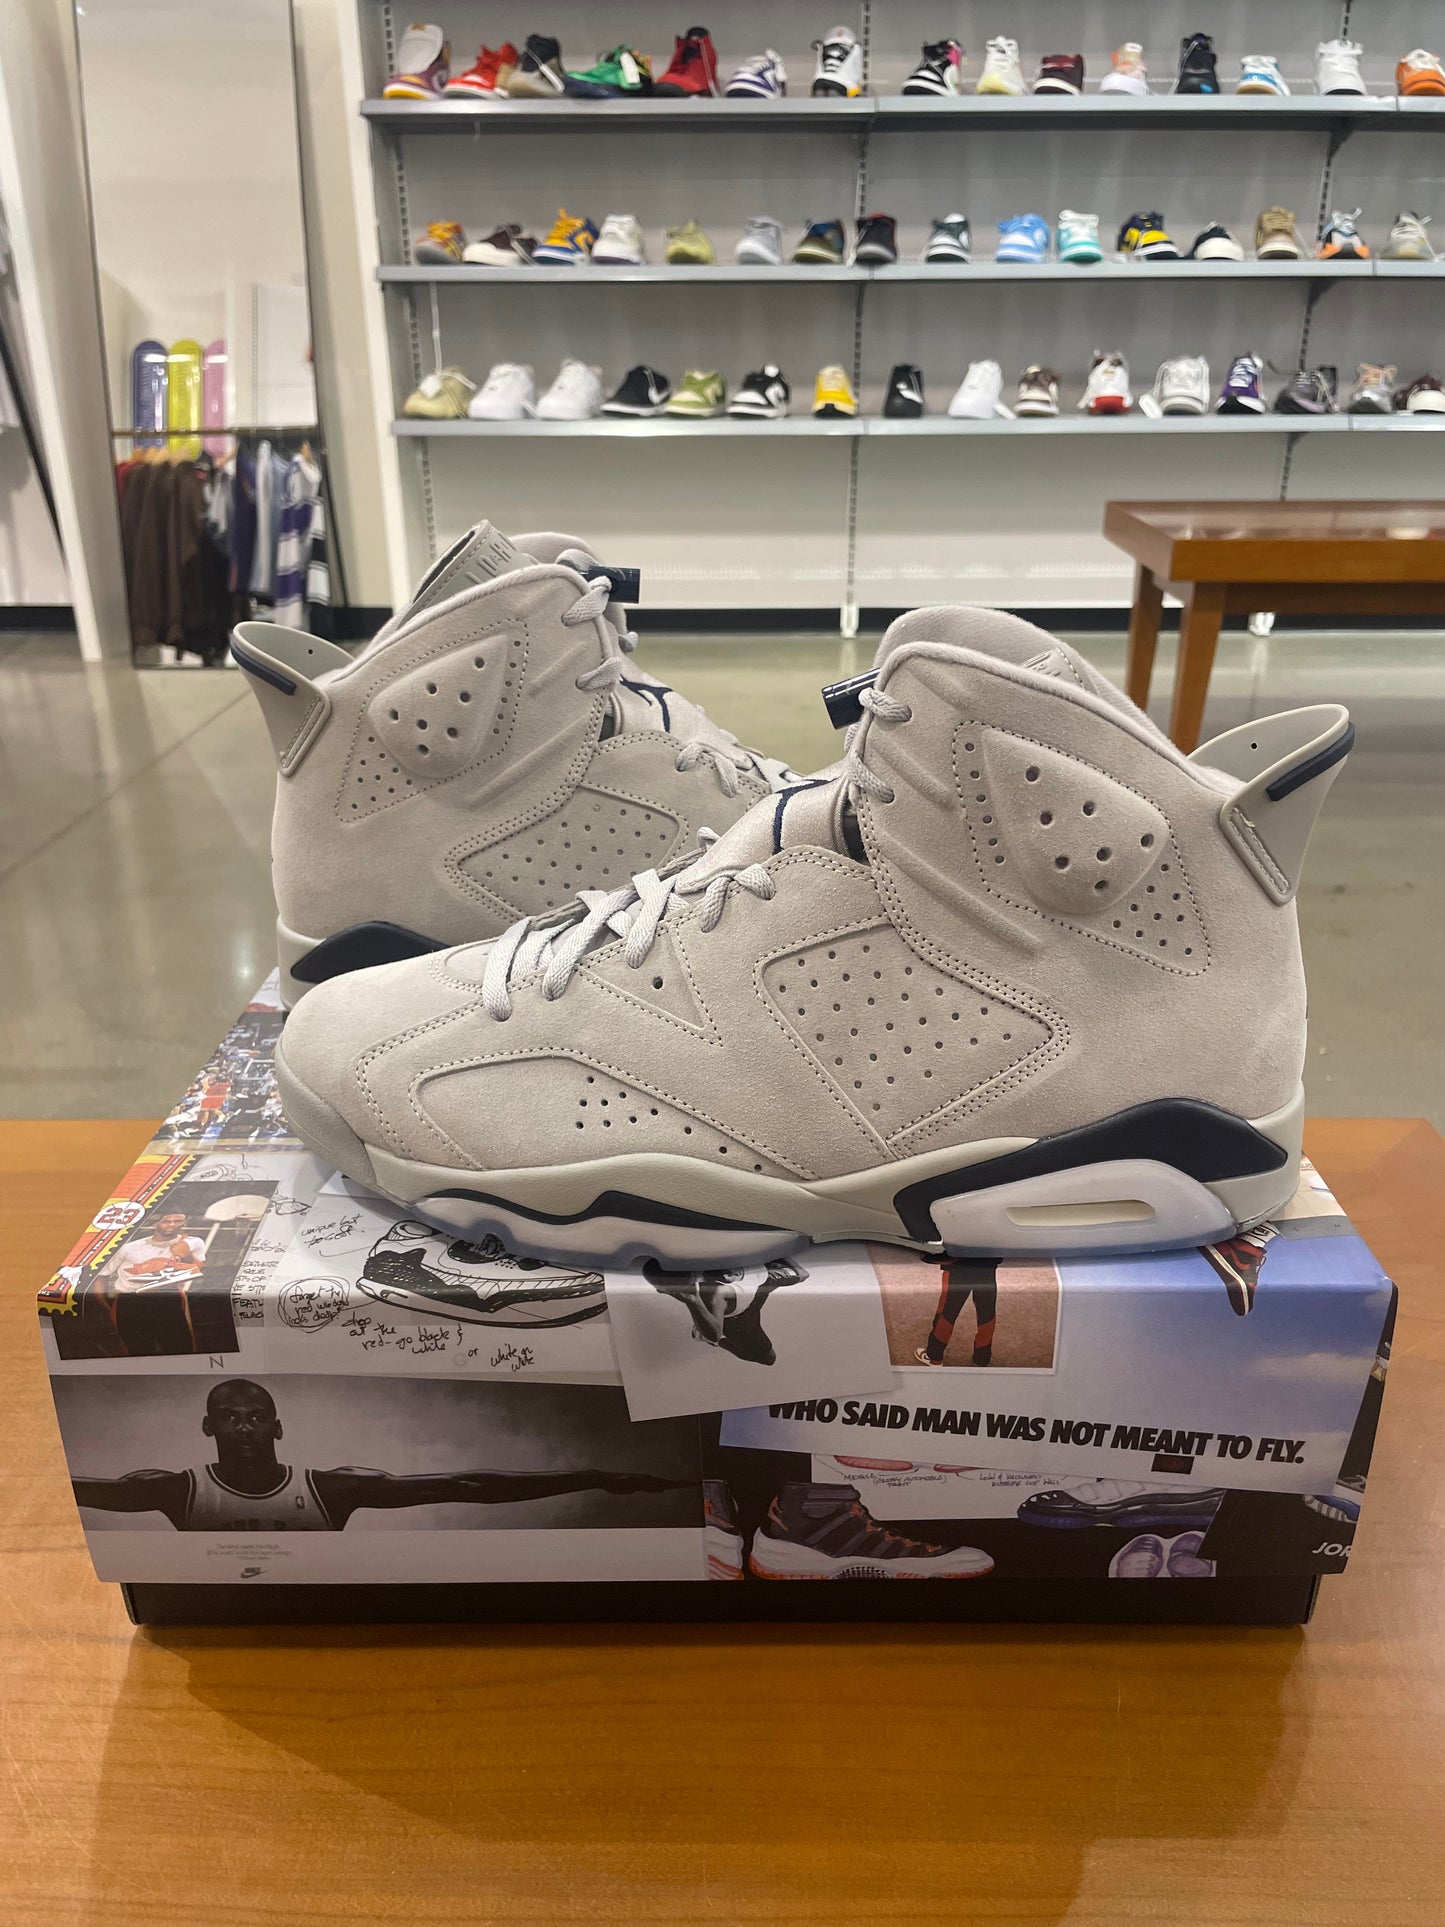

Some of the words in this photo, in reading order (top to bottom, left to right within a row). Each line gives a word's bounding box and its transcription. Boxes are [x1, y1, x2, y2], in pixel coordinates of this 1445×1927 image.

[97, 1207, 140, 1225] 23
[417, 1326, 450, 1342] black
[412, 1341, 446, 1354] white
[468, 1348, 478, 1357] or
[768, 1398, 838, 1423] WHO
[841, 1400, 909, 1430] SAID
[912, 1407, 981, 1436] MAN
[987, 1413, 1046, 1442] WAS
[1049, 1419, 1111, 1447] NOT
[1110, 1425, 1213, 1457] MEANT
[1217, 1434, 1252, 1460] TO
[1256, 1438, 1306, 1464] FLY.
